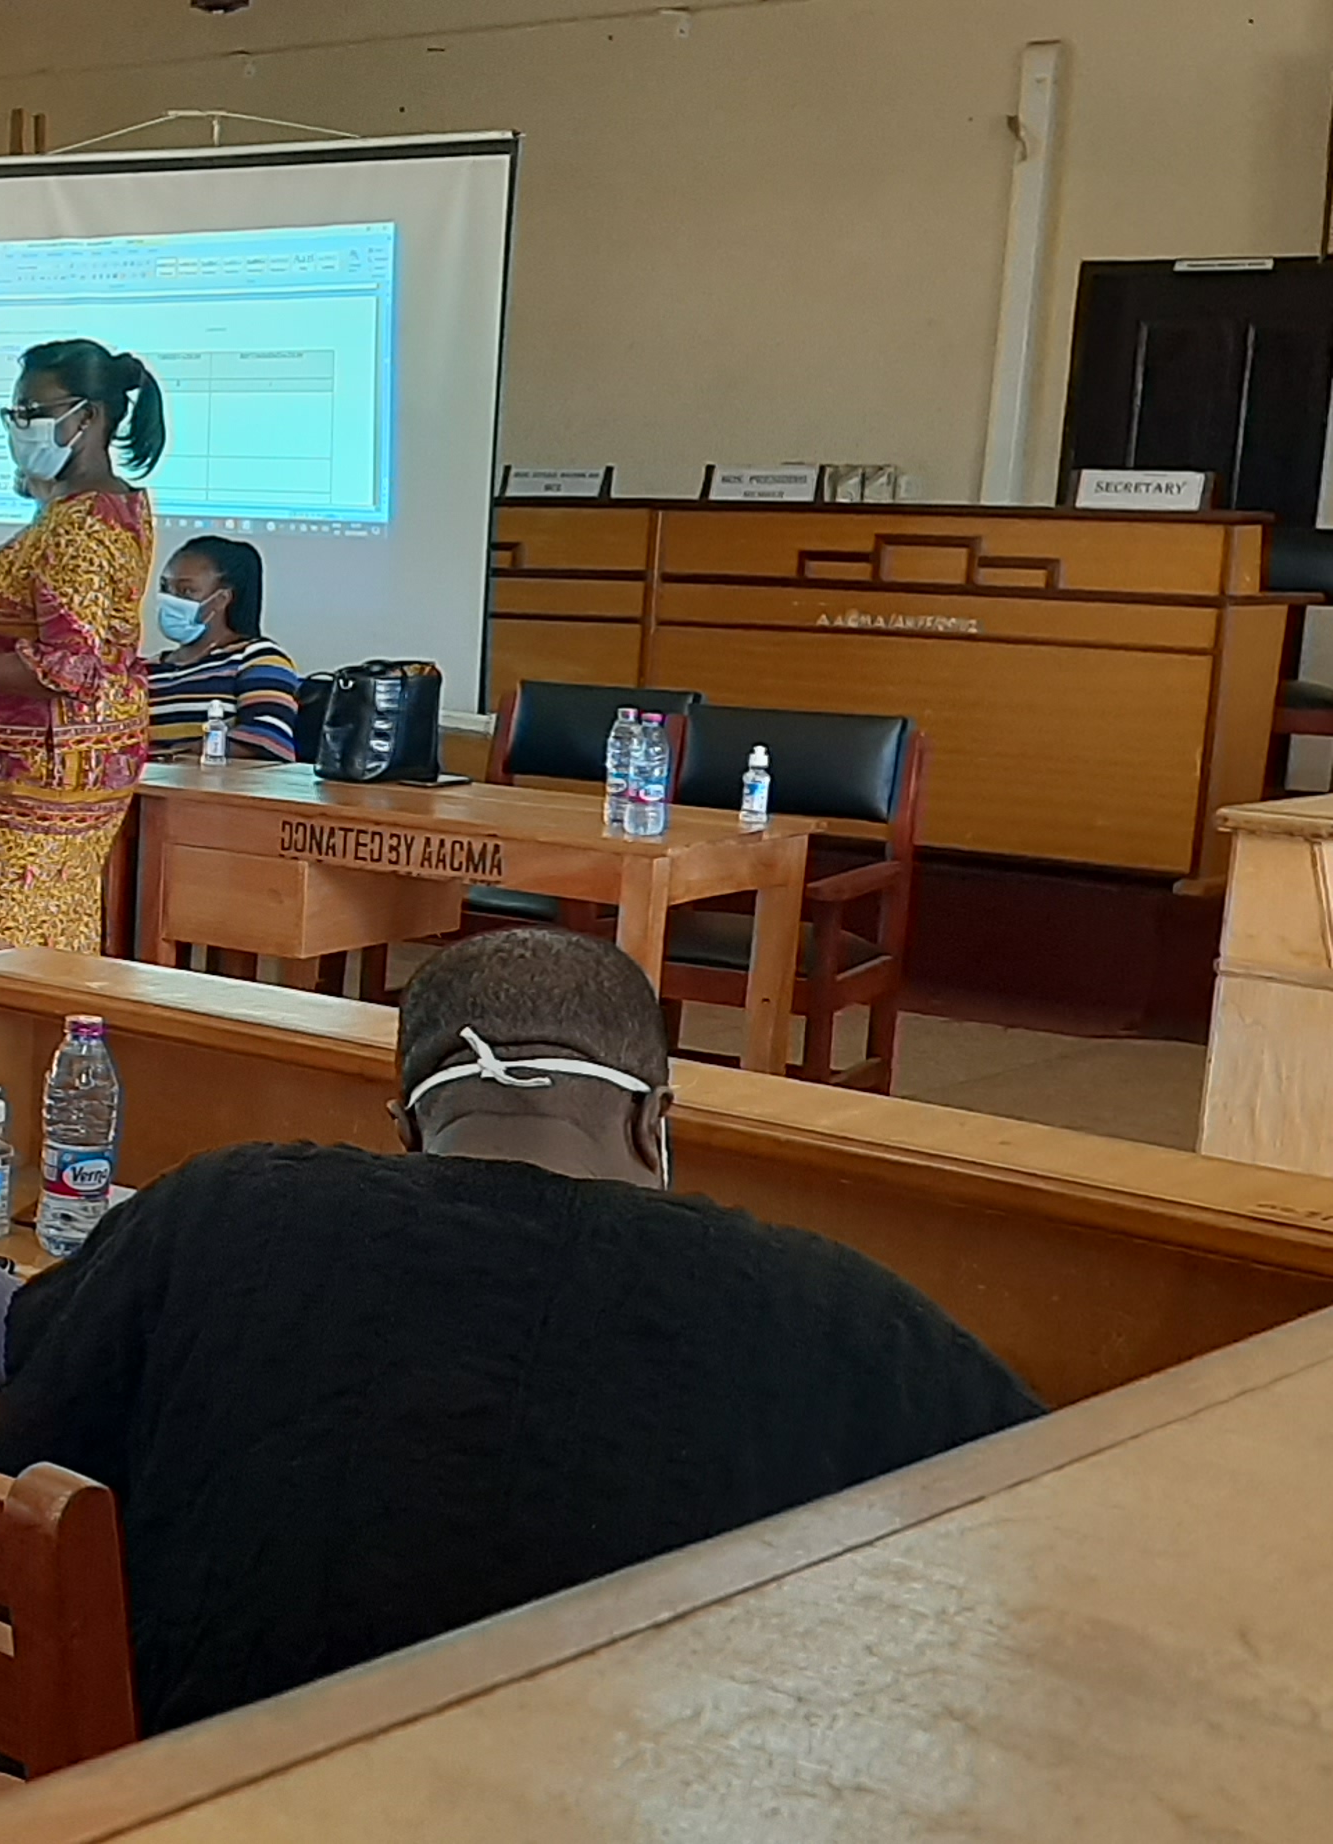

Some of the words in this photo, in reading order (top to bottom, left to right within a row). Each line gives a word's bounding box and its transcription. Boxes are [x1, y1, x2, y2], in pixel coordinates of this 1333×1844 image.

[1094, 480, 1188, 495] SECRETARY
[280, 820, 384, 864] DONATED
[388, 833, 416, 866] BY
[419, 836, 503, 877] AACMA
